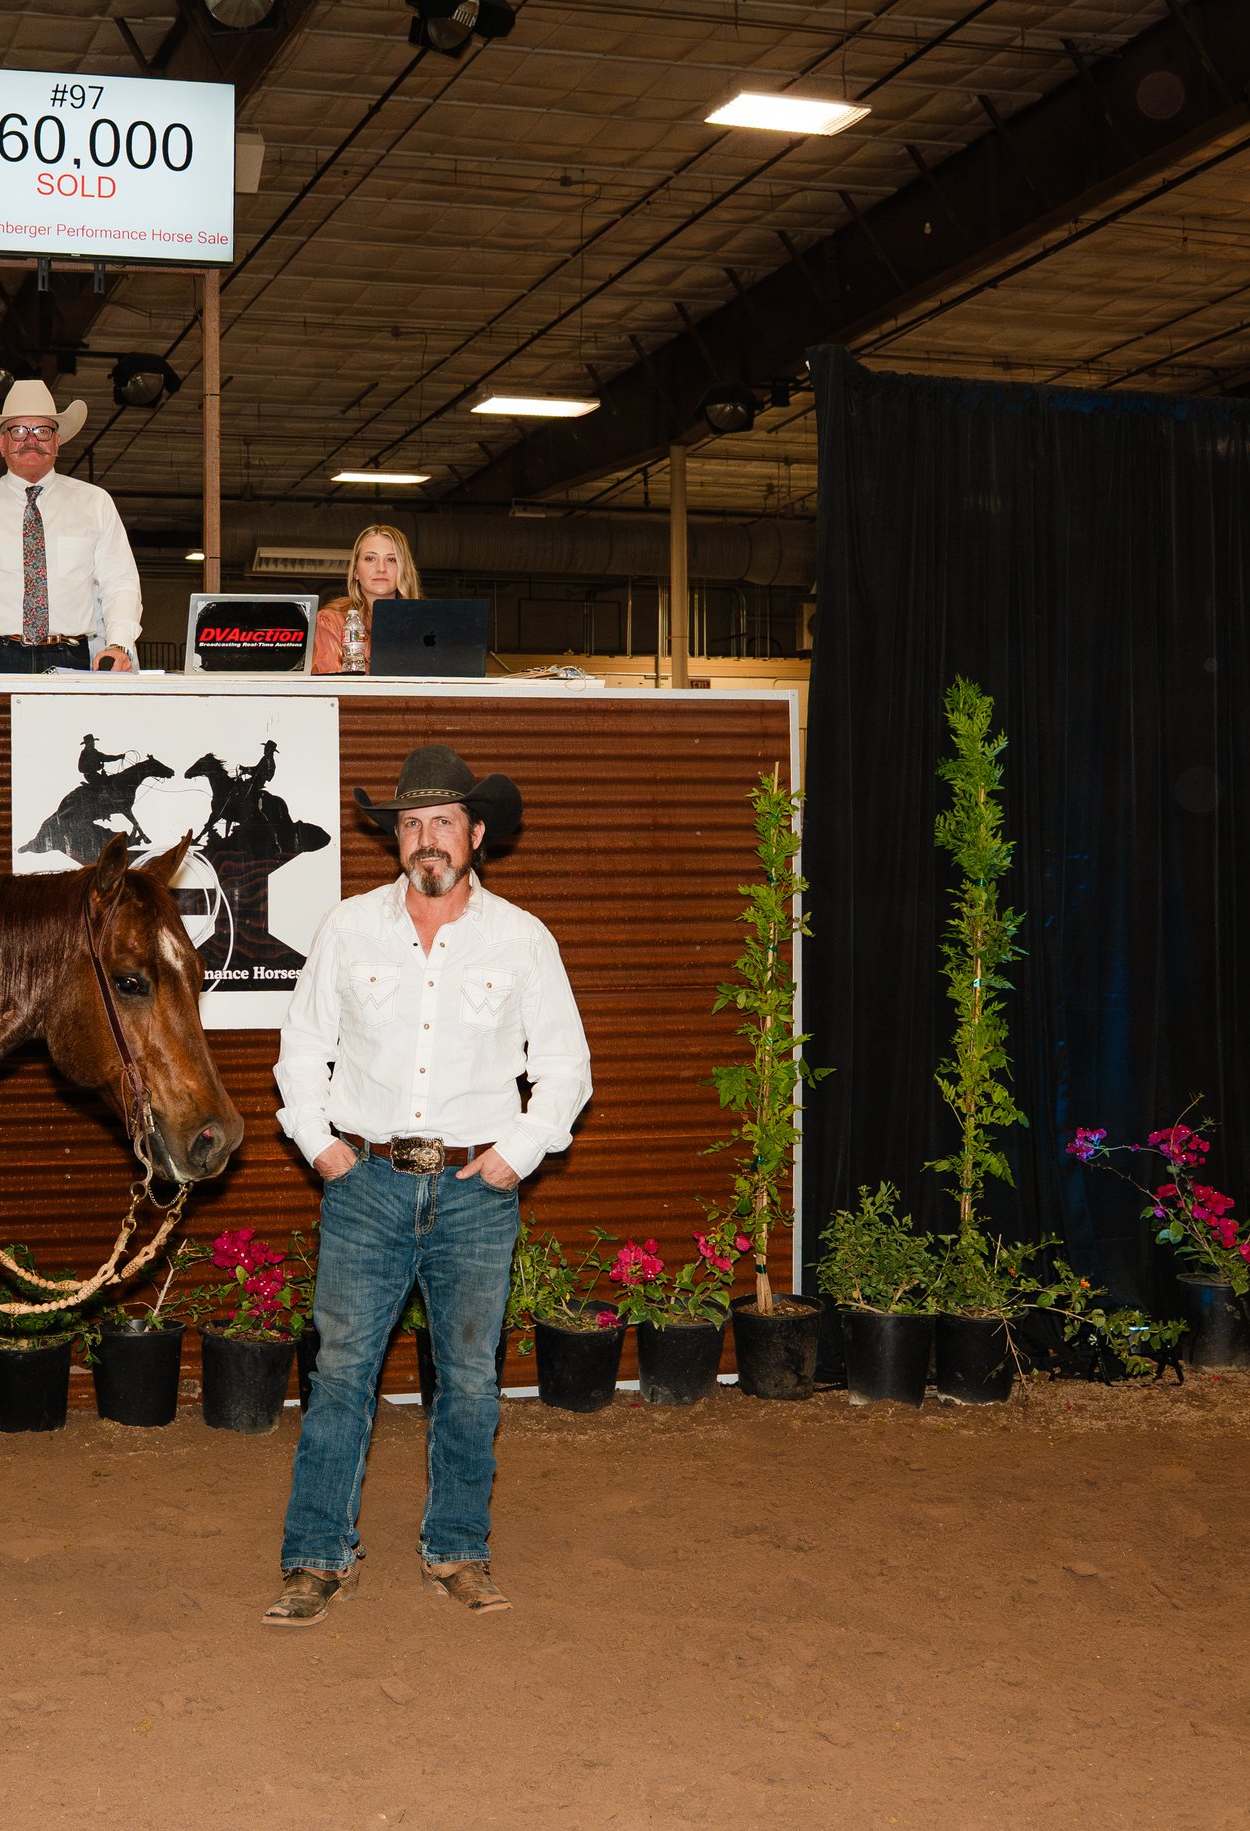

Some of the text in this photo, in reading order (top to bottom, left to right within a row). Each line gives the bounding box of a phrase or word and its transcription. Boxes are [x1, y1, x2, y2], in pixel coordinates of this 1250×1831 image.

[50, 84, 104, 109] #97
[36, 172, 117, 199] SOLD
[56, 223, 147, 241] Performance
[151, 229, 193, 243] Horse
[197, 231, 229, 245] Sale
[199, 627, 305, 642] DVAuction
[253, 966, 302, 980] Horses
